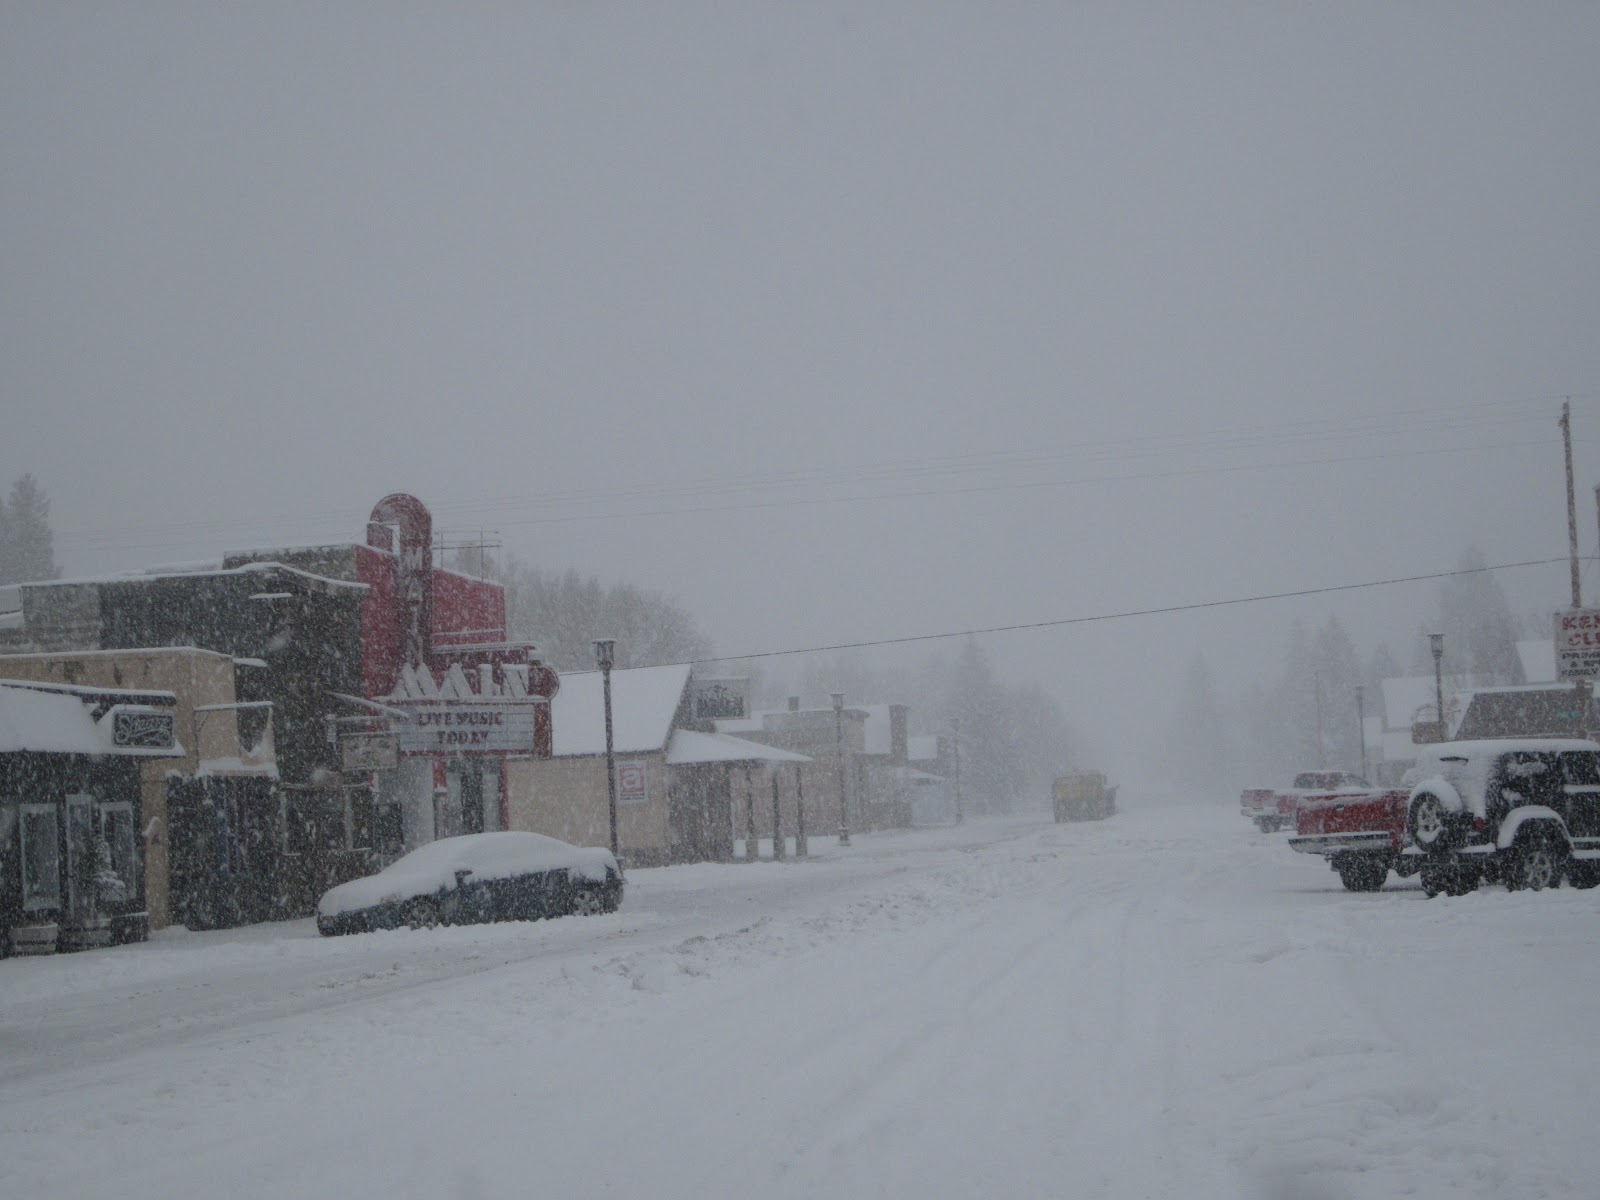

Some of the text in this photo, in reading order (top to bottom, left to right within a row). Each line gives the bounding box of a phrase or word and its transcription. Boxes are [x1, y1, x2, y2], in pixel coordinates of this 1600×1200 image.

[1561, 668, 1598, 676] FAMILY
[418, 711, 503, 726] LIVE MUSIC
[437, 730, 488, 744] TODAY
